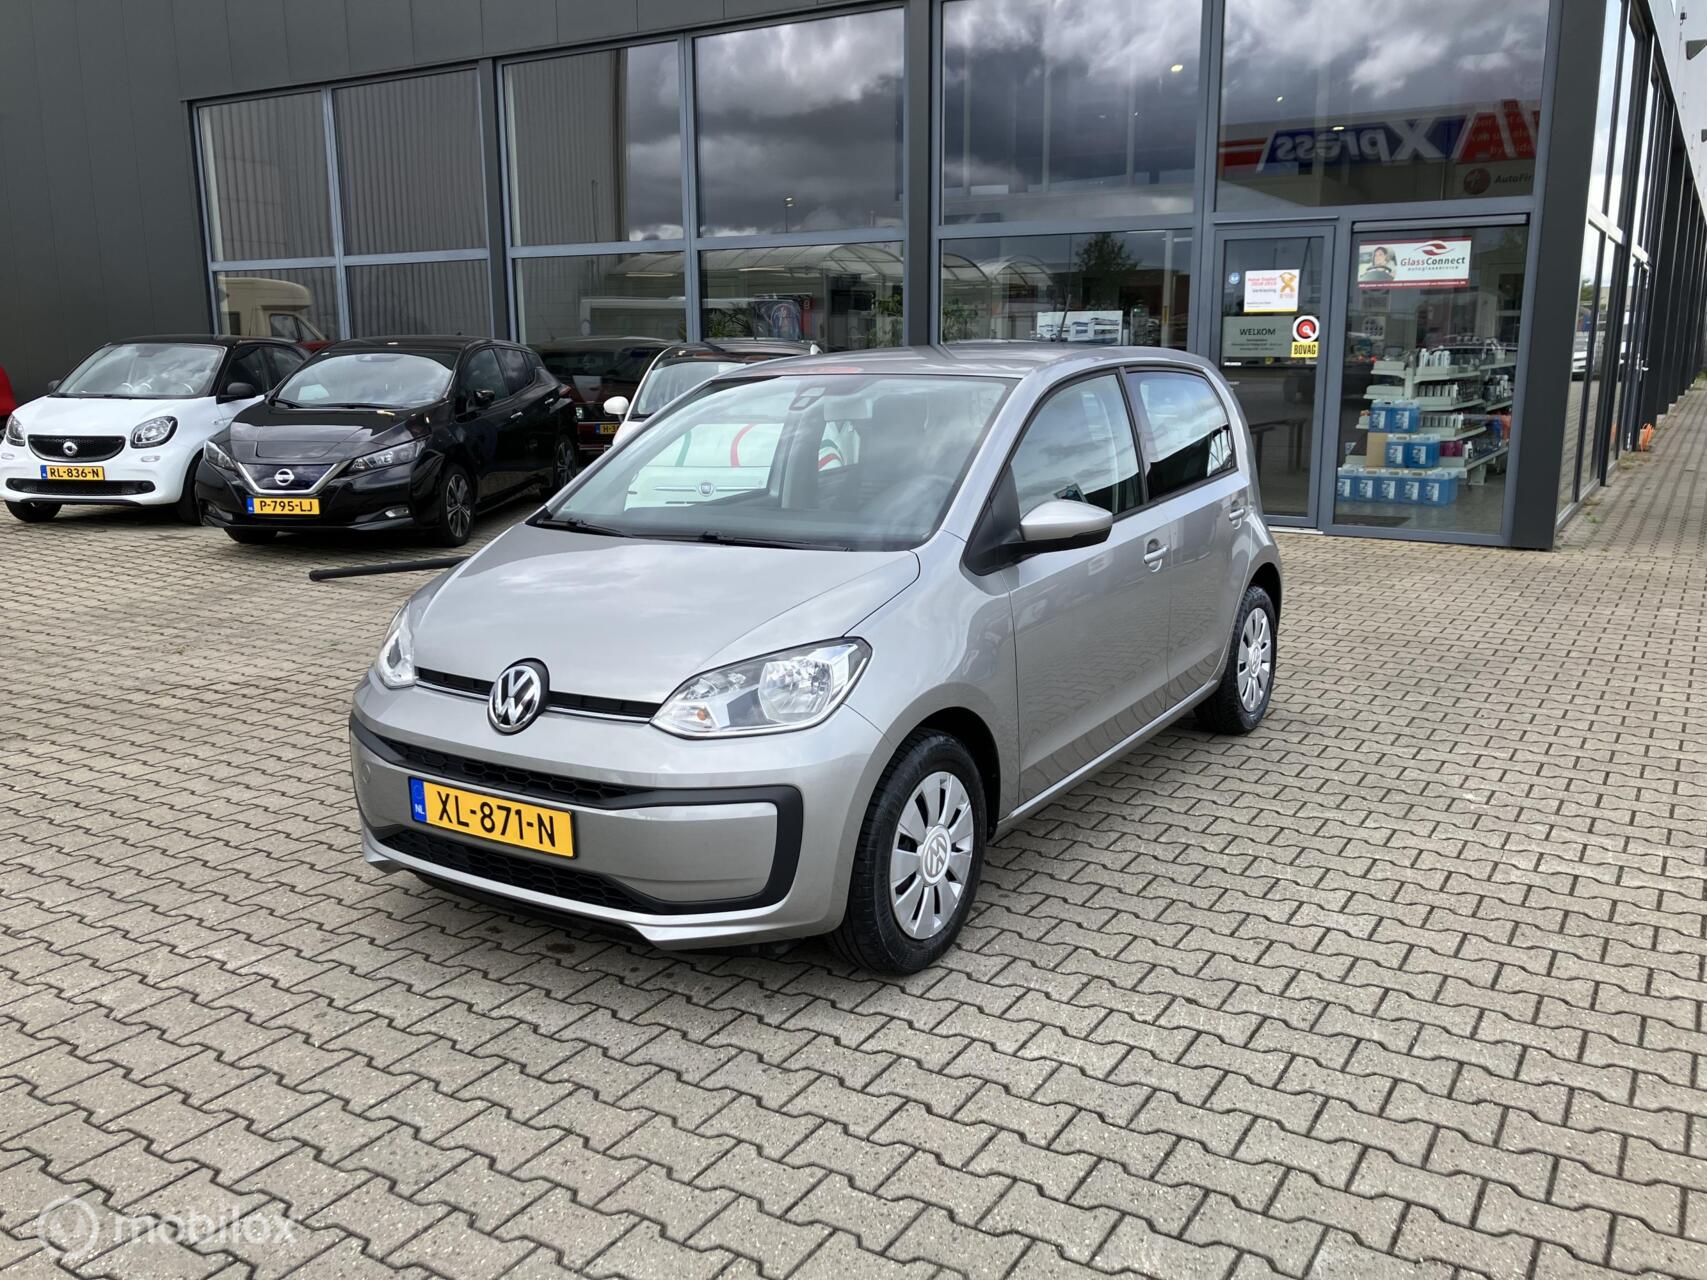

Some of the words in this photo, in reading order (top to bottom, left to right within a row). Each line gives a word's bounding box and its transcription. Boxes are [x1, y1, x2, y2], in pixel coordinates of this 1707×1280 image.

[1400, 256, 1466, 267] GlassConnect
[1239, 328, 1276, 336] WELKOM
[1293, 343, 1317, 355] BOVAG
[49, 465, 100, 479] RL-836-N
[259, 501, 313, 513] P-795-LJ
[414, 803, 425, 816] NL
[436, 790, 556, 848] XL-871-N
